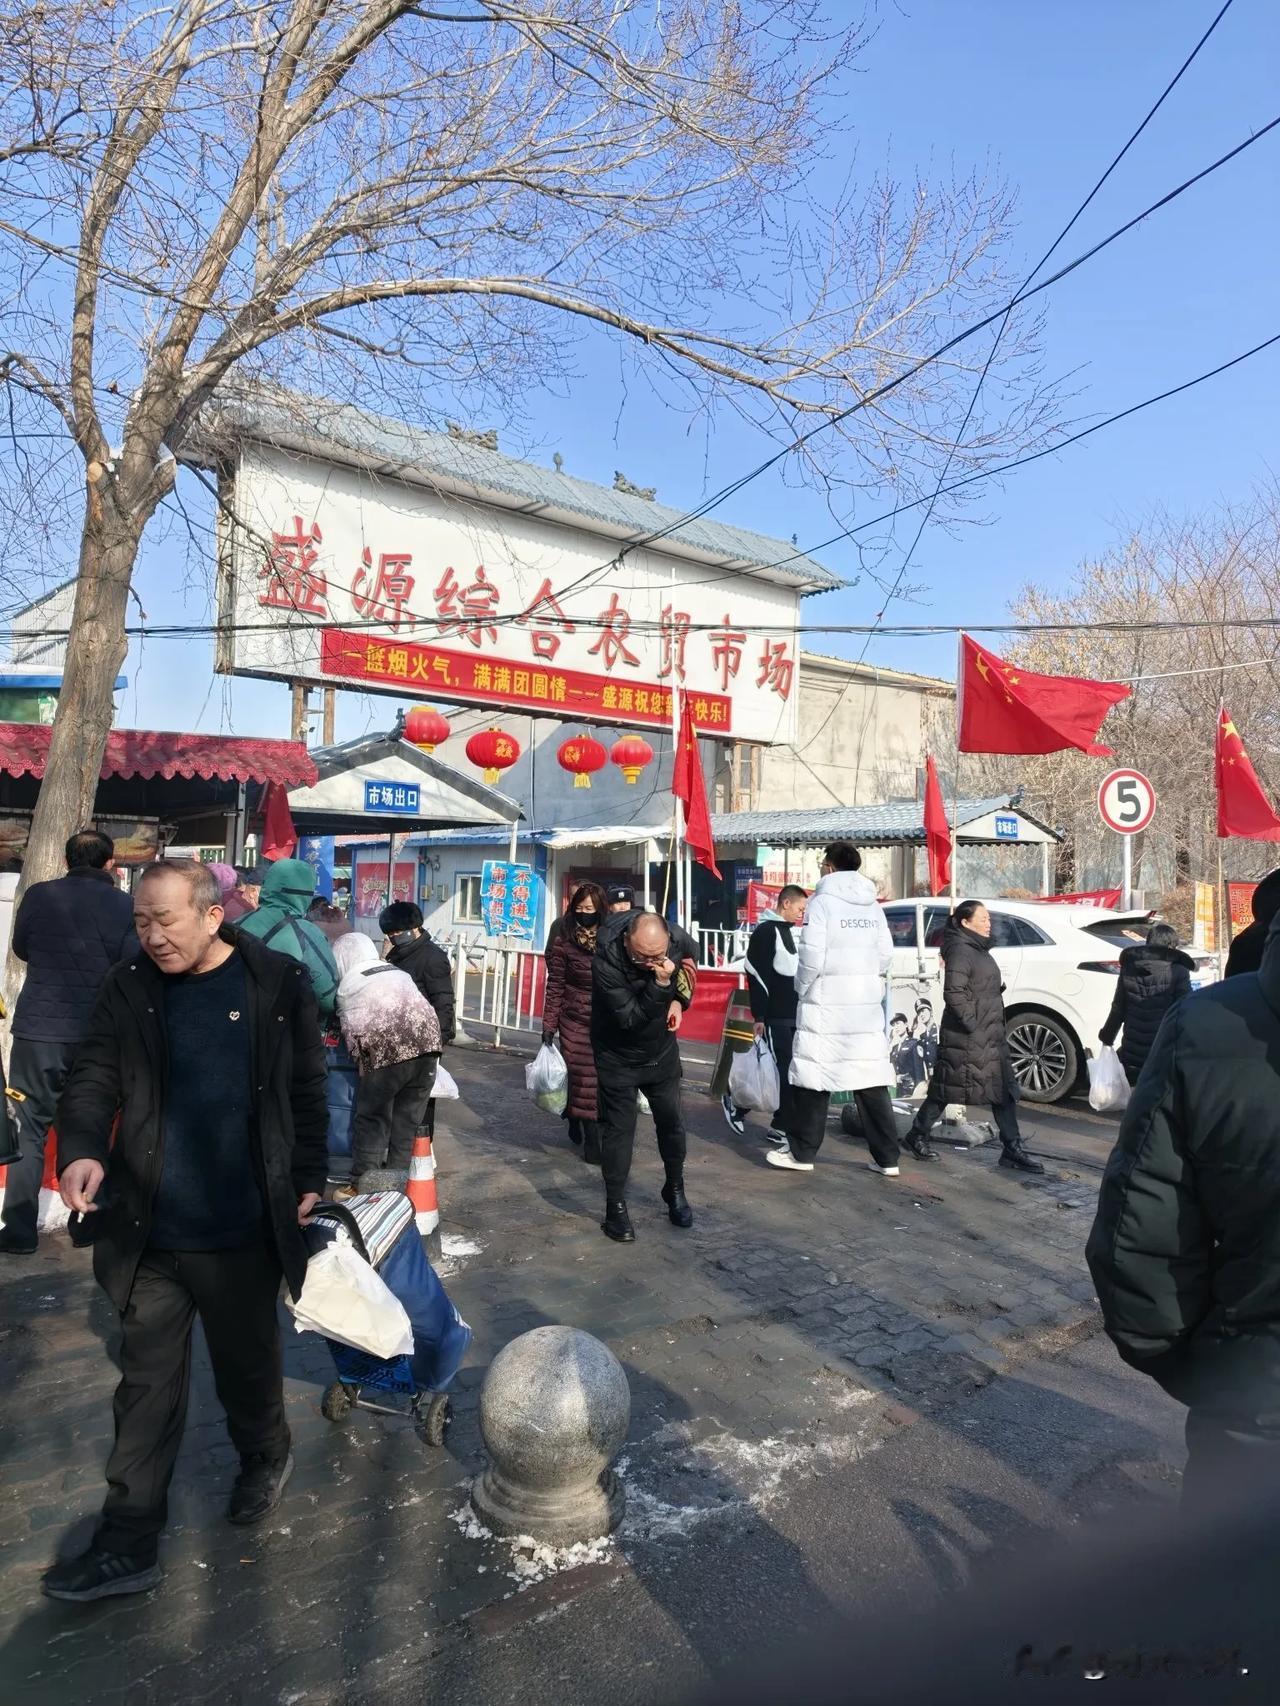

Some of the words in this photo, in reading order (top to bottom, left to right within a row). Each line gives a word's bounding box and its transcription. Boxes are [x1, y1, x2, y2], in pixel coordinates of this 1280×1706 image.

[257, 514, 795, 703] 盛源综合农贸市场
[368, 786, 418, 807] 市场出口
[1117, 780, 1142, 823] 5
[512, 869, 533, 934] 不得进入
